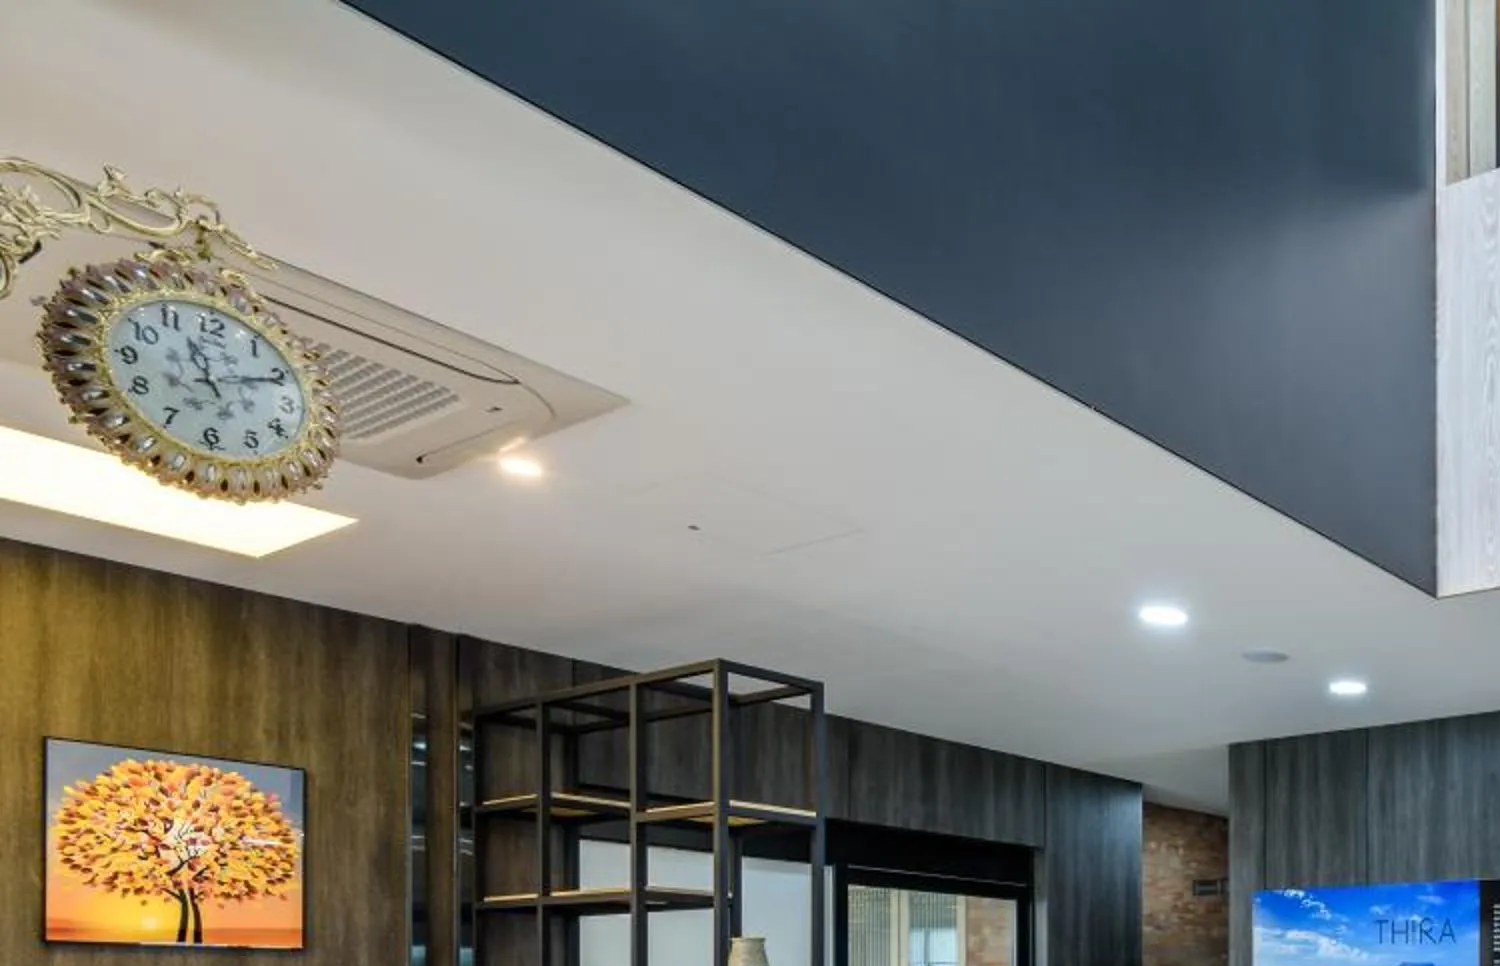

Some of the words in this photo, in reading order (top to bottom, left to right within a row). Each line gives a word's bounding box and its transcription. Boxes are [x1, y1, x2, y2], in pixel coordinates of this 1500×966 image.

[161, 303, 181, 332] 11
[199, 317, 226, 338] 12
[127, 317, 159, 345] 10
[115, 346, 139, 365] 9
[250, 334, 261, 358] 1
[128, 376, 150, 397] 8
[270, 368, 288, 385] 2
[281, 396, 295, 415] 3
[162, 407, 180, 428] 7
[200, 428, 224, 449] 6
[267, 418, 289, 439] 4
[242, 430, 259, 450] 5
[1375, 917, 1456, 945] THIRA
